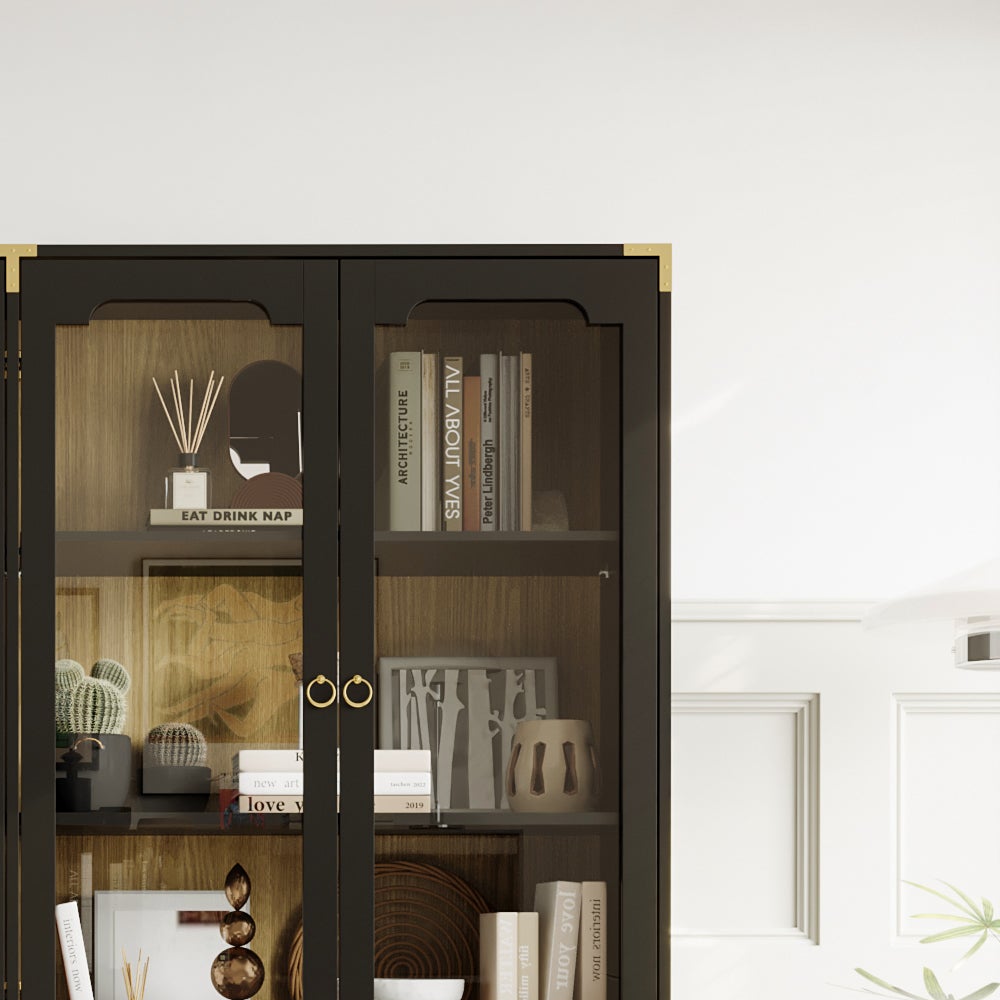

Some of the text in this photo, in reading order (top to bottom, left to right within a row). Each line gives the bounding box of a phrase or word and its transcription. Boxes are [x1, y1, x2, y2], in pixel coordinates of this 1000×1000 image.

[445, 365, 461, 398] ALL
[398, 390, 408, 485] ARCHITECTURE
[445, 403, 461, 467] ABOUT
[445, 475, 461, 519] YVES
[483, 439, 495, 524] Peter Lindbergh
[181, 511, 293, 521] EAT DRINK NAP
[248, 796, 285, 811] love
[254, 779, 300, 788] new art
[63, 918, 83, 993] interiors now
